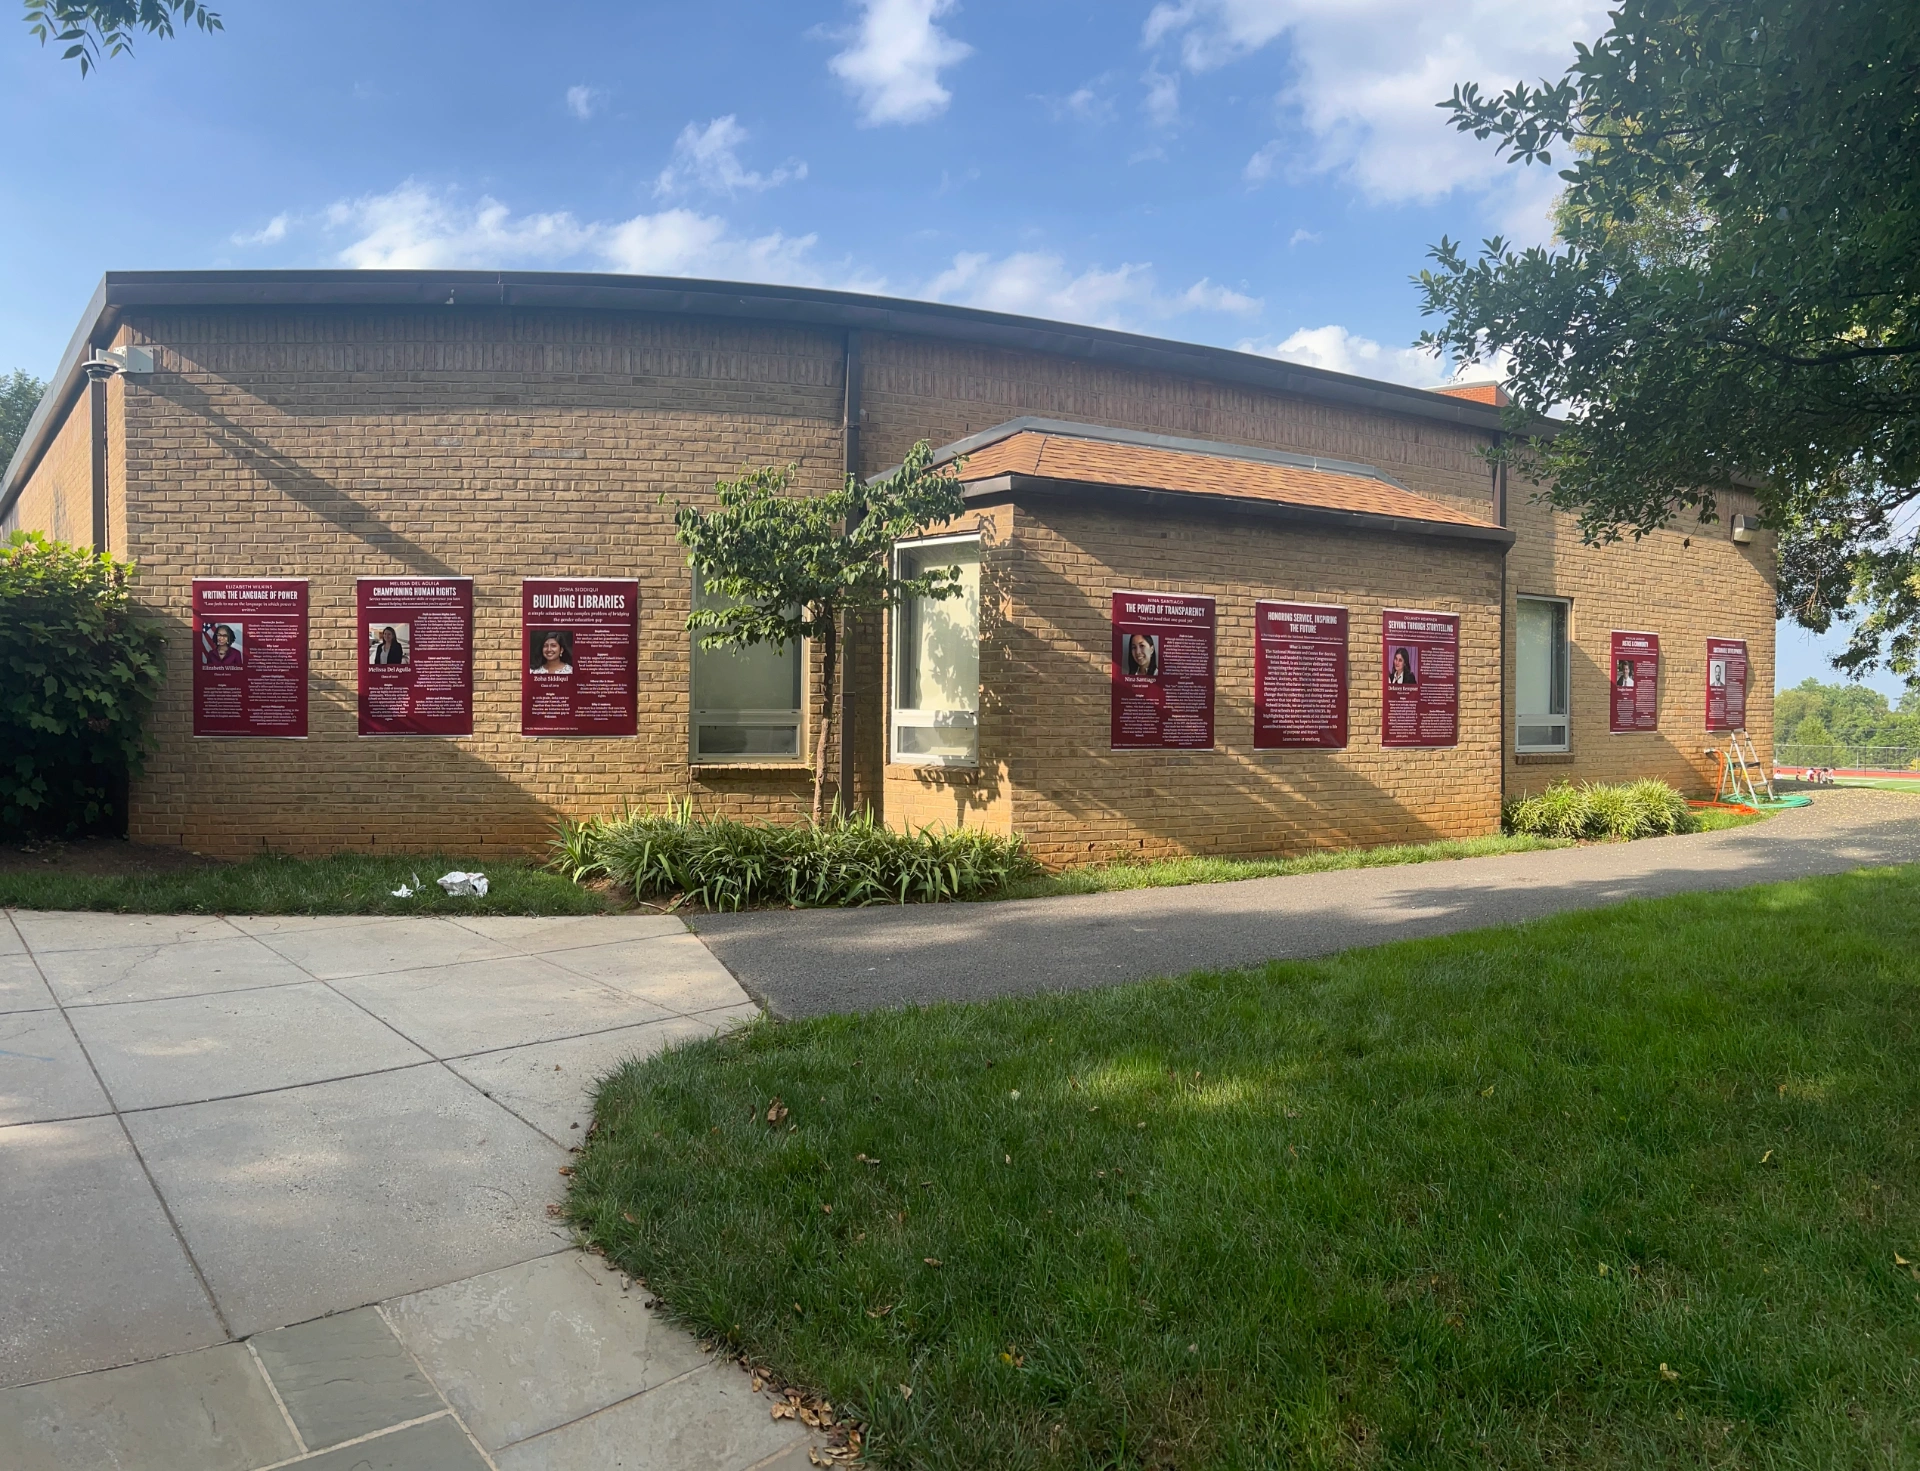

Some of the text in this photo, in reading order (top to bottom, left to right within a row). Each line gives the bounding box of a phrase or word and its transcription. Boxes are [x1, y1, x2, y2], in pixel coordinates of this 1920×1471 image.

[202, 591, 298, 599] WRITING THE LANGUAGE OF POWER
[373, 587, 456, 596] CHAMPIONING HUMAN RIGHTS
[533, 595, 625, 609] BUILDING LIBRARIES
[1126, 603, 1205, 616] THE POWER OF TRANSPARENCY
[1268, 612, 1337, 624] HONORING SERVICE, INSPIRING
[1290, 624, 1316, 633] THE FUTURE
[1388, 621, 1453, 632] SERVING THROUGH STORYTELLING
